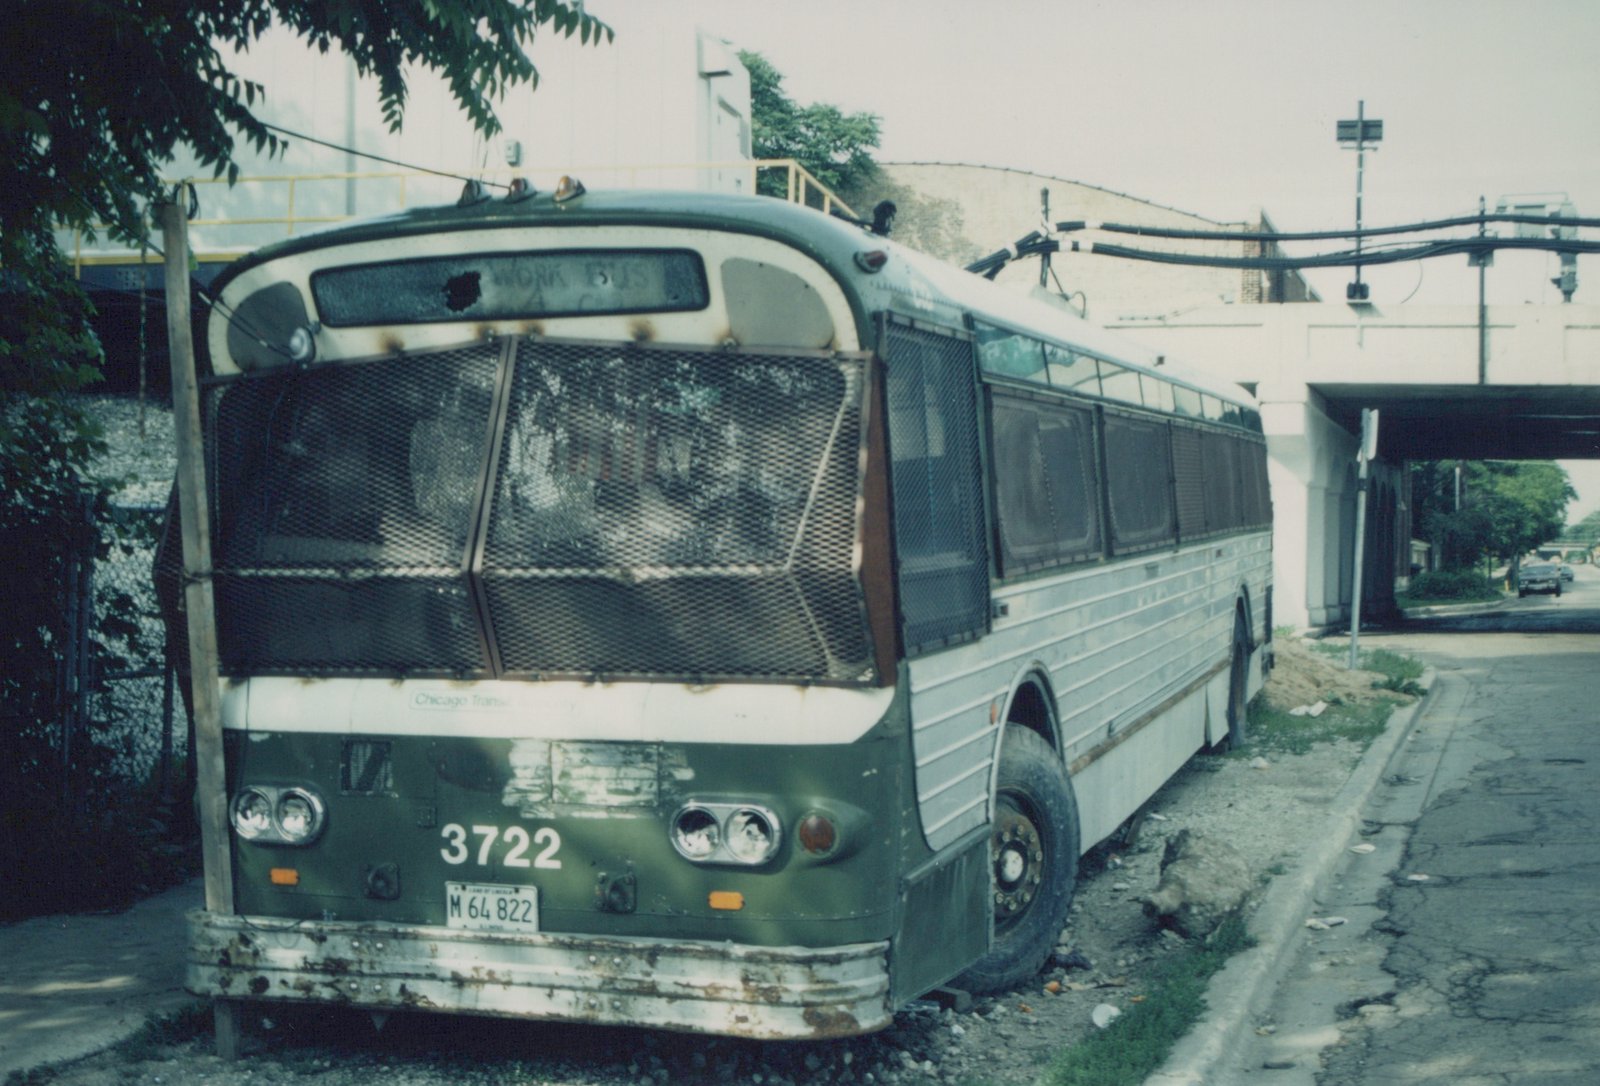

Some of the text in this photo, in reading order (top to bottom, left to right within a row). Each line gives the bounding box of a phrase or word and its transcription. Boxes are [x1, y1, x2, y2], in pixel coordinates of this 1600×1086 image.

[414, 692, 468, 708] Chicago
[440, 823, 562, 869] 3722
[450, 894, 532, 923] M 64 822
